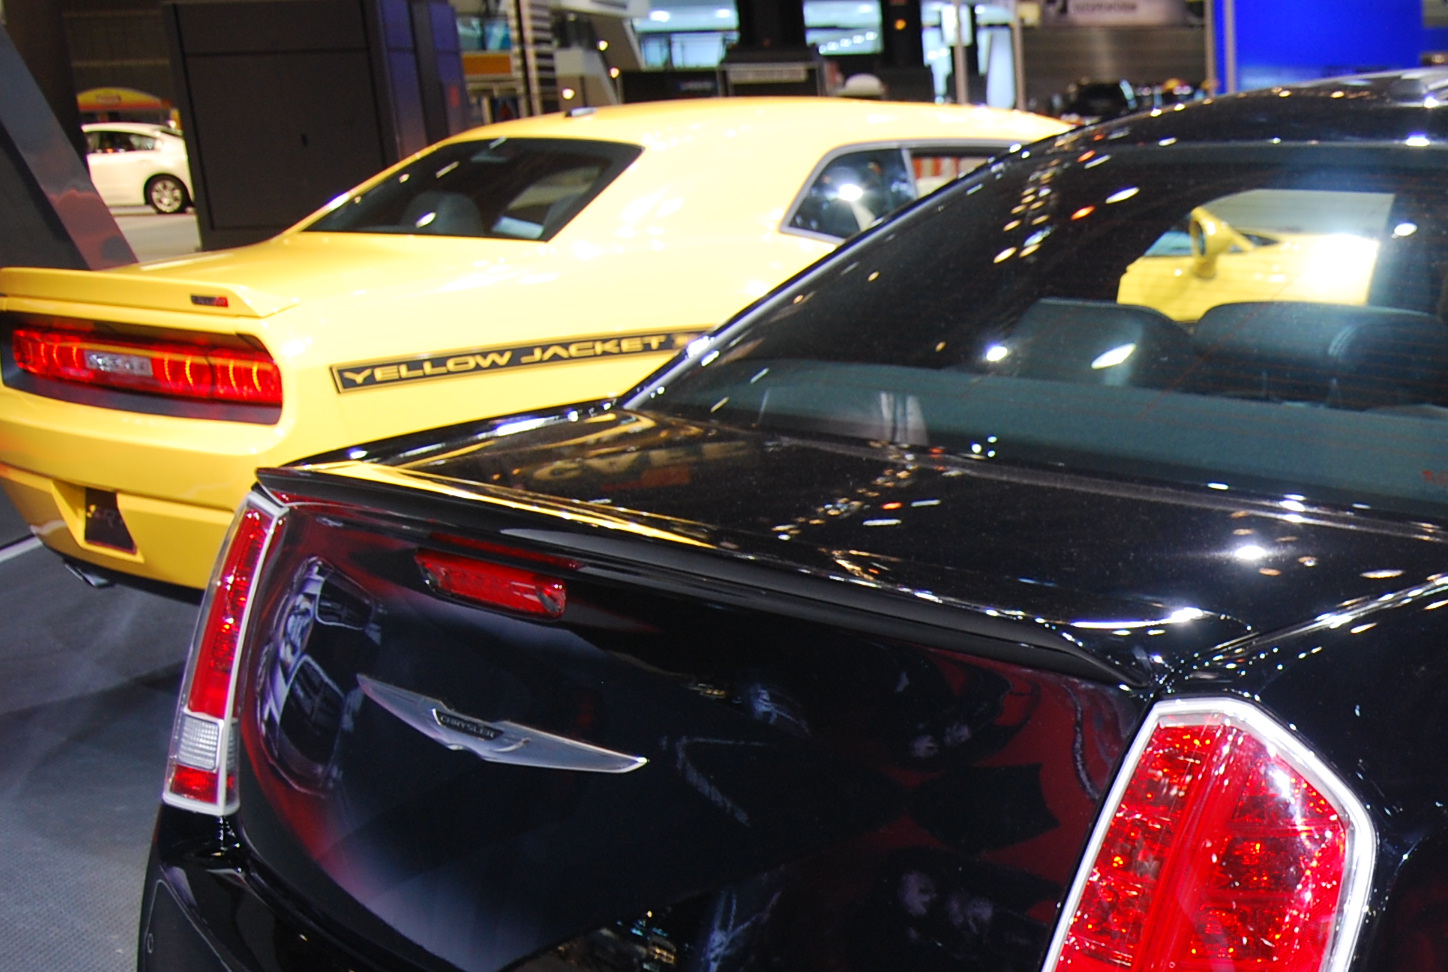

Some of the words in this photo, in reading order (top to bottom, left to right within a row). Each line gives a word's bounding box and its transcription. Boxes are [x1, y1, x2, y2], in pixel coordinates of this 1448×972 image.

[343, 351, 512, 385] YELLOW
[520, 334, 667, 364] JACKET
[440, 715, 495, 738] CHRYSLER
